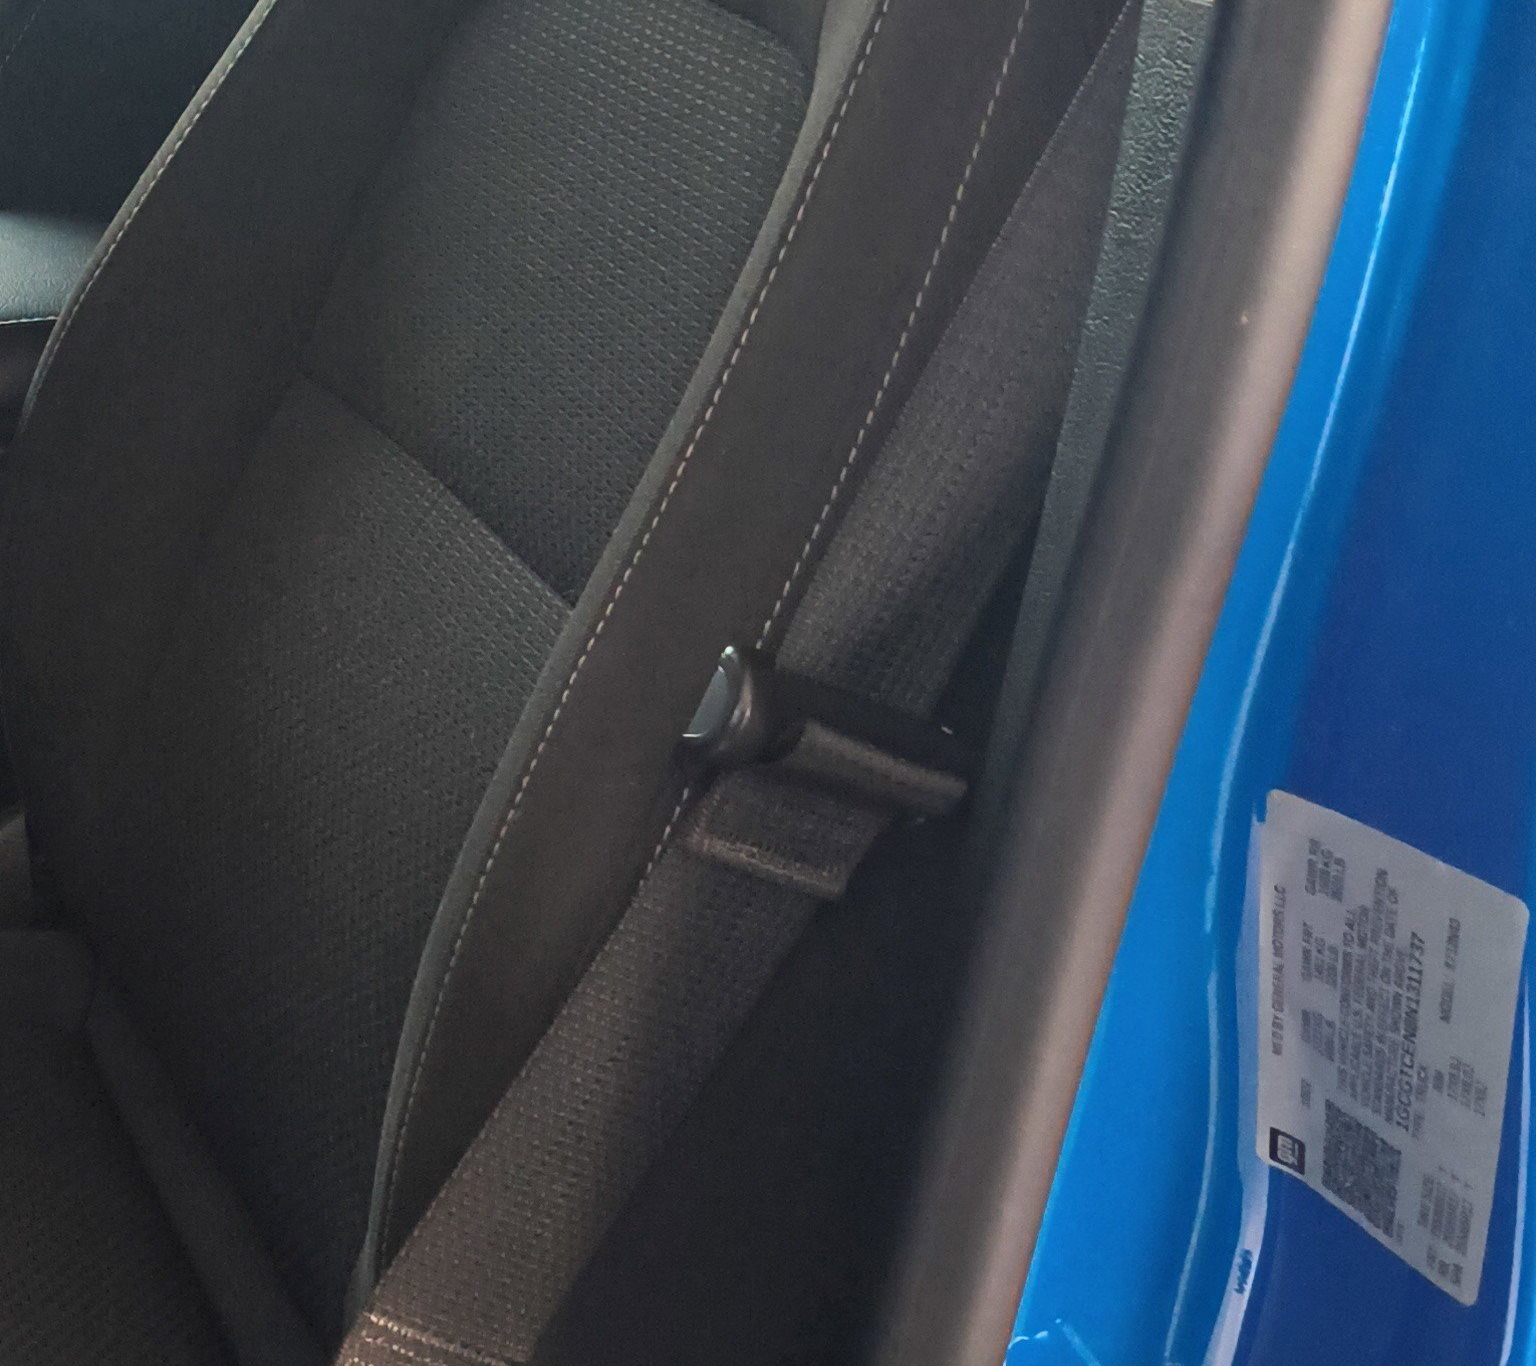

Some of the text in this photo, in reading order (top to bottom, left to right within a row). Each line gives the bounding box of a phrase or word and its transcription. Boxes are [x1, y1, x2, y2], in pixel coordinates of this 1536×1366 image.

[1273, 882, 1286, 910] LLC
[1272, 906, 1284, 961] MOTORS
[1271, 957, 1284, 1015] GENERAL
